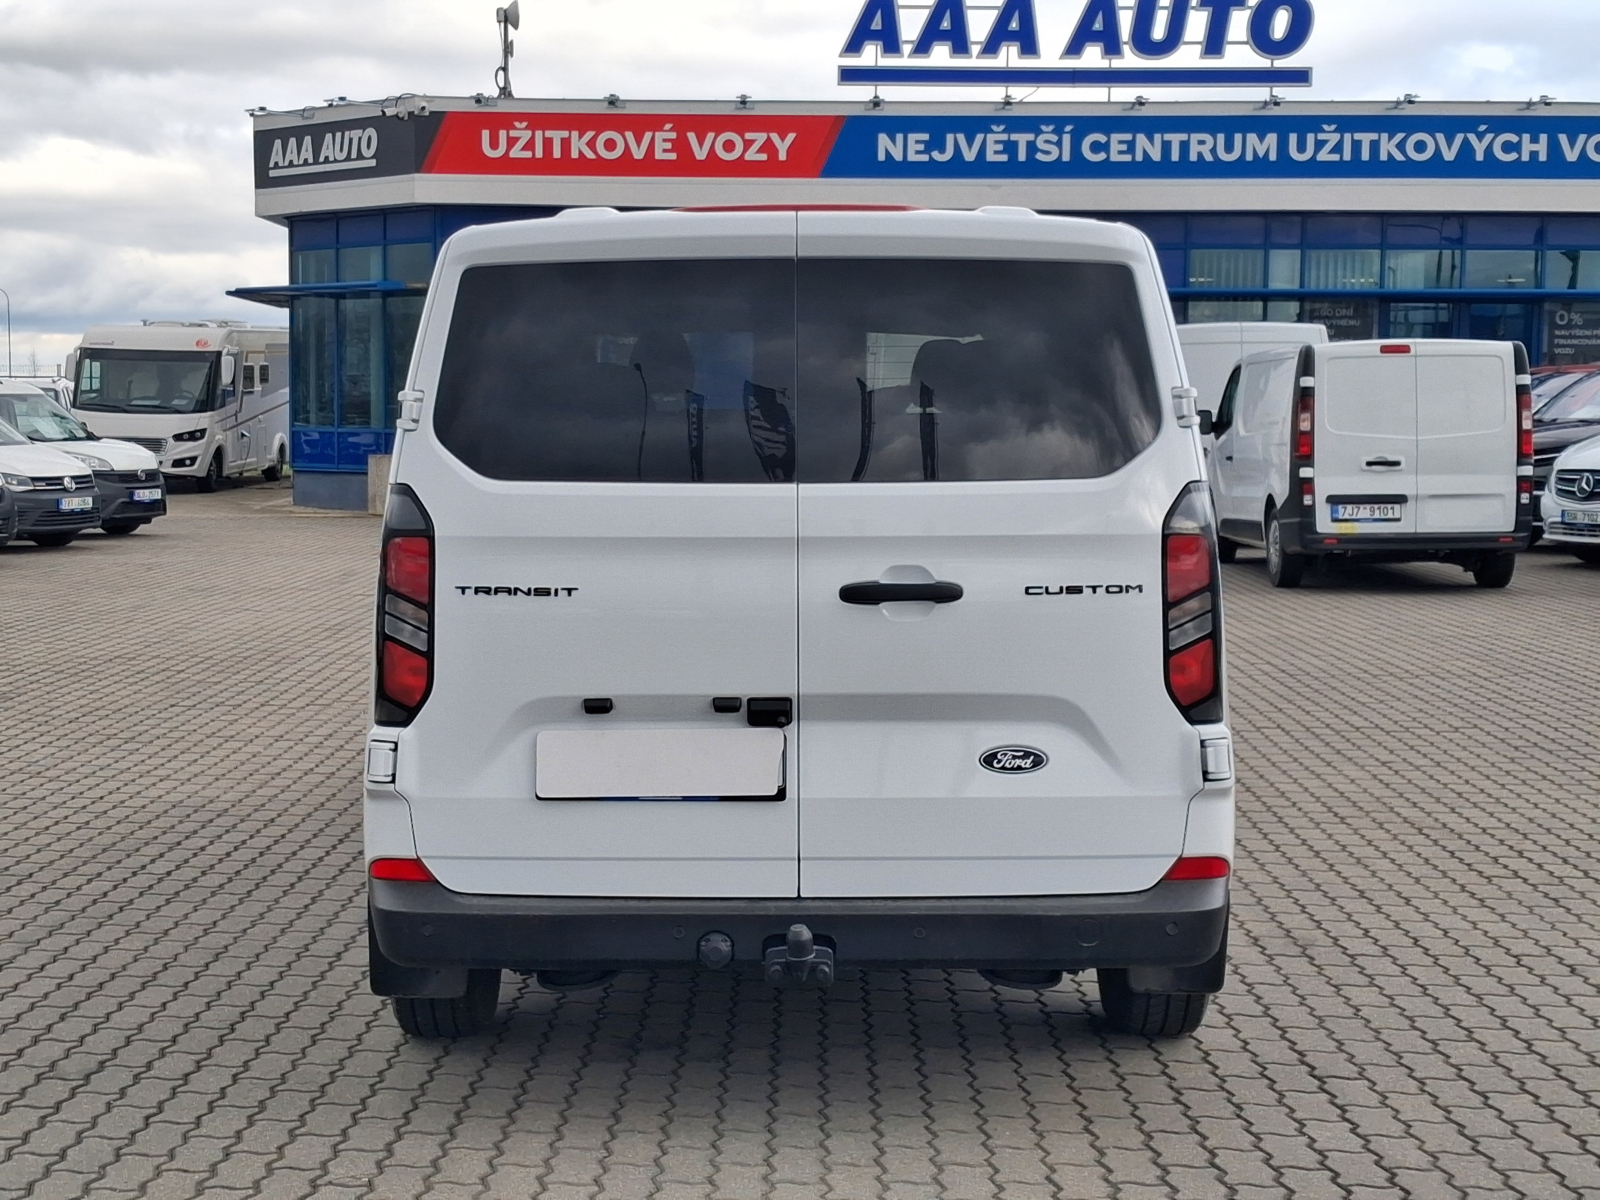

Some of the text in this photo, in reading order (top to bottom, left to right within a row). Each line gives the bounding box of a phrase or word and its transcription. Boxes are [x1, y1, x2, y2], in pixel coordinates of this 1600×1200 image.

[838, 0, 1316, 60] AAA AUTO
[268, 127, 378, 168] AAA AUTO
[481, 121, 797, 162] UŽITKOVÉ VOZY
[877, 124, 1075, 162] NEJVĚTŠÍ
[1081, 132, 1278, 162] CENTRUM
[1288, 124, 1548, 162] UŽITKOVÝCH
[1341, 505, 1395, 517] 7J7 9101
[454, 585, 579, 598] TRANSIT
[1024, 584, 1144, 596] CUSTOM
[993, 750, 1035, 769] Ford
